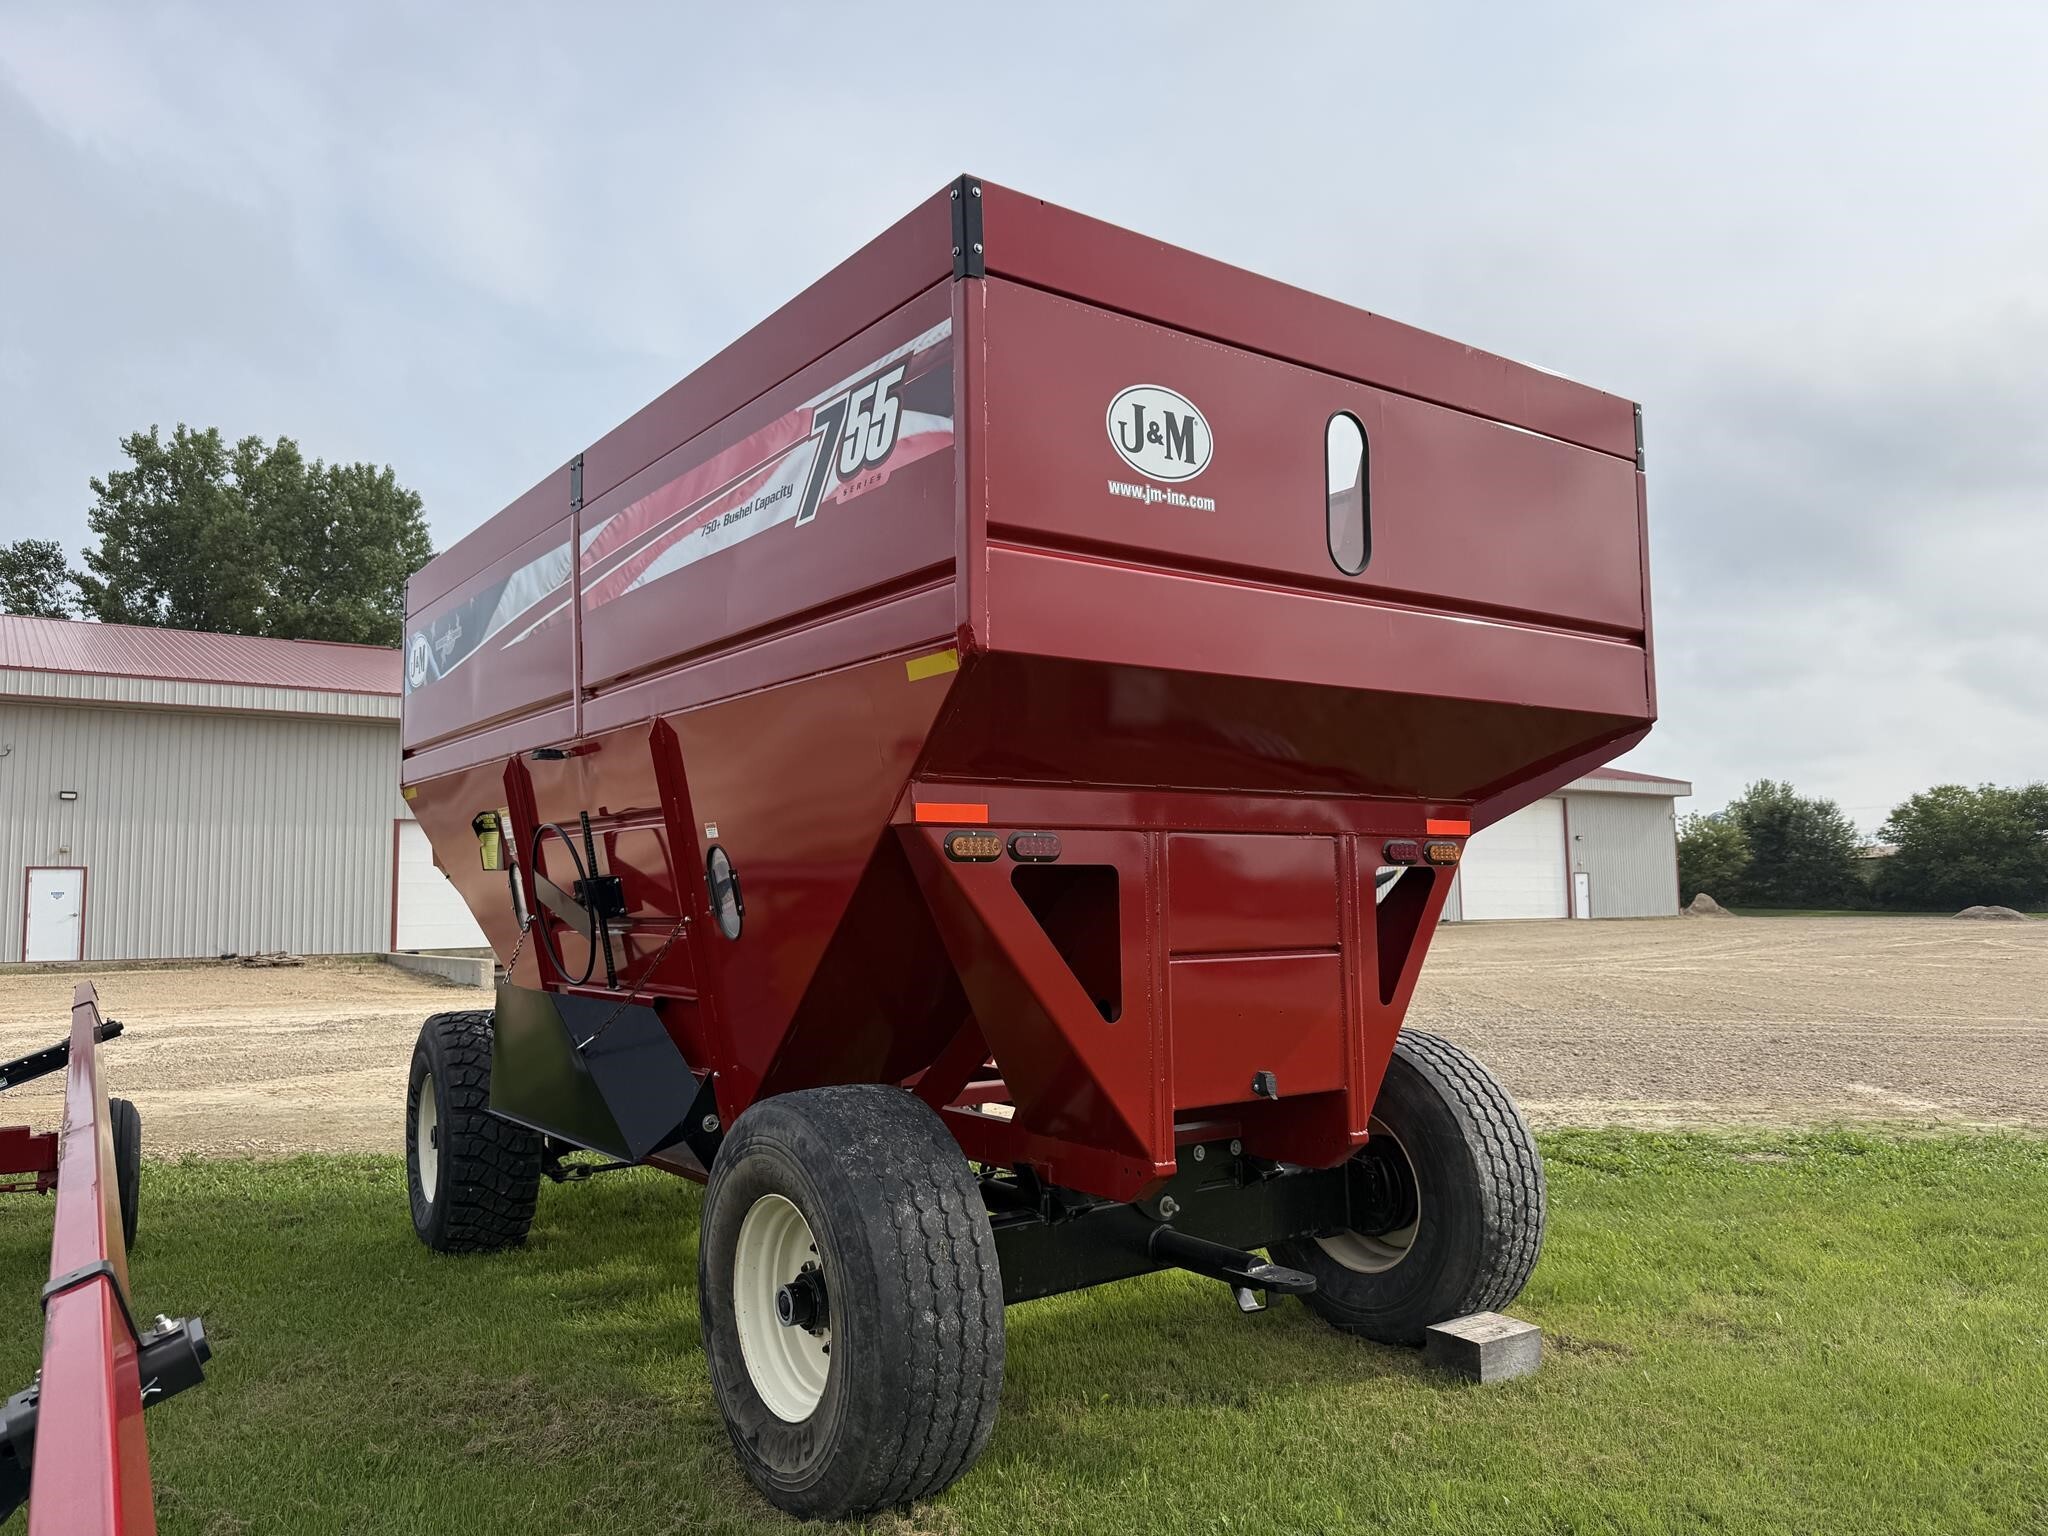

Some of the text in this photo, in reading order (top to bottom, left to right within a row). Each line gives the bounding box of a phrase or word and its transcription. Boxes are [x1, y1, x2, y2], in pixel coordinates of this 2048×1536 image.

[795, 365, 905, 528] 755
[1118, 403, 1197, 465] J&M
[701, 483, 794, 537] 750+ Bushel Capacity
[843, 473, 882, 496] SERIES
[1108, 480, 1215, 512] www.jm-inc.com
